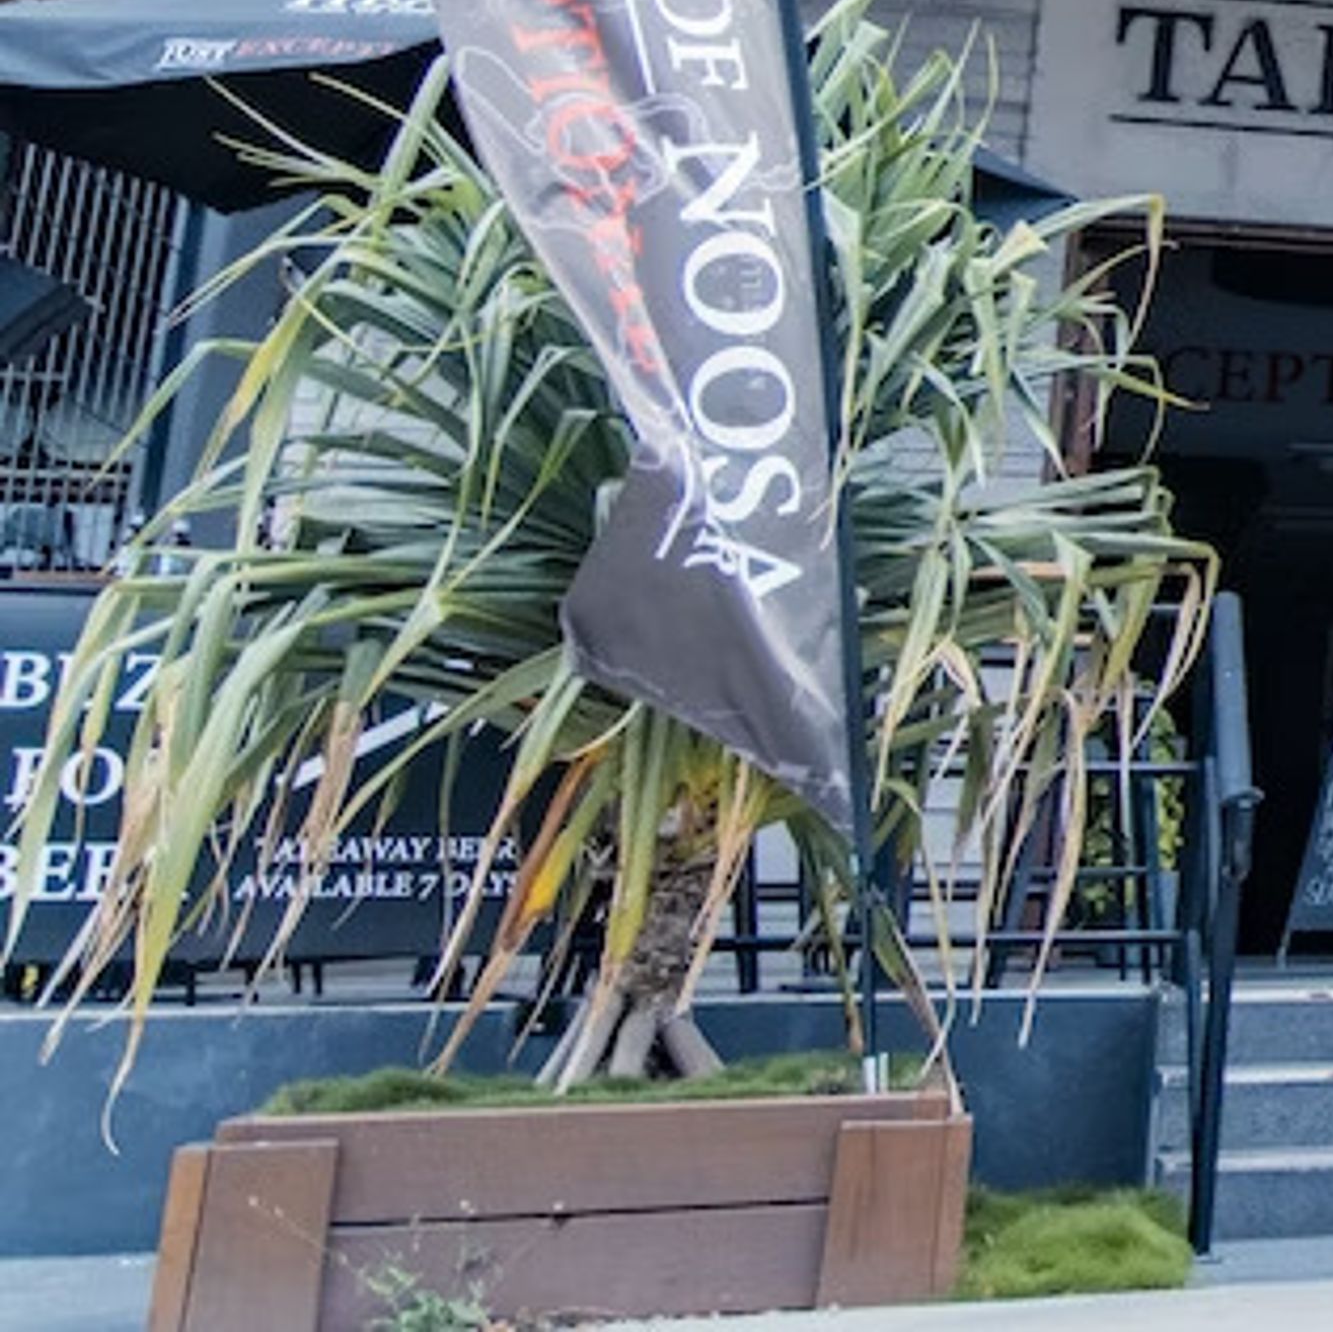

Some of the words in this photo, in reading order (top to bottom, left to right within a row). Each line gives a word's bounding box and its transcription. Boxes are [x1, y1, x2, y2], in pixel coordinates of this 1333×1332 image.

[661, 134, 803, 602] NOOSA
[234, 871, 414, 899] AVALABLE
[417, 872, 440, 901] 7
[447, 871, 519, 898] DYS
